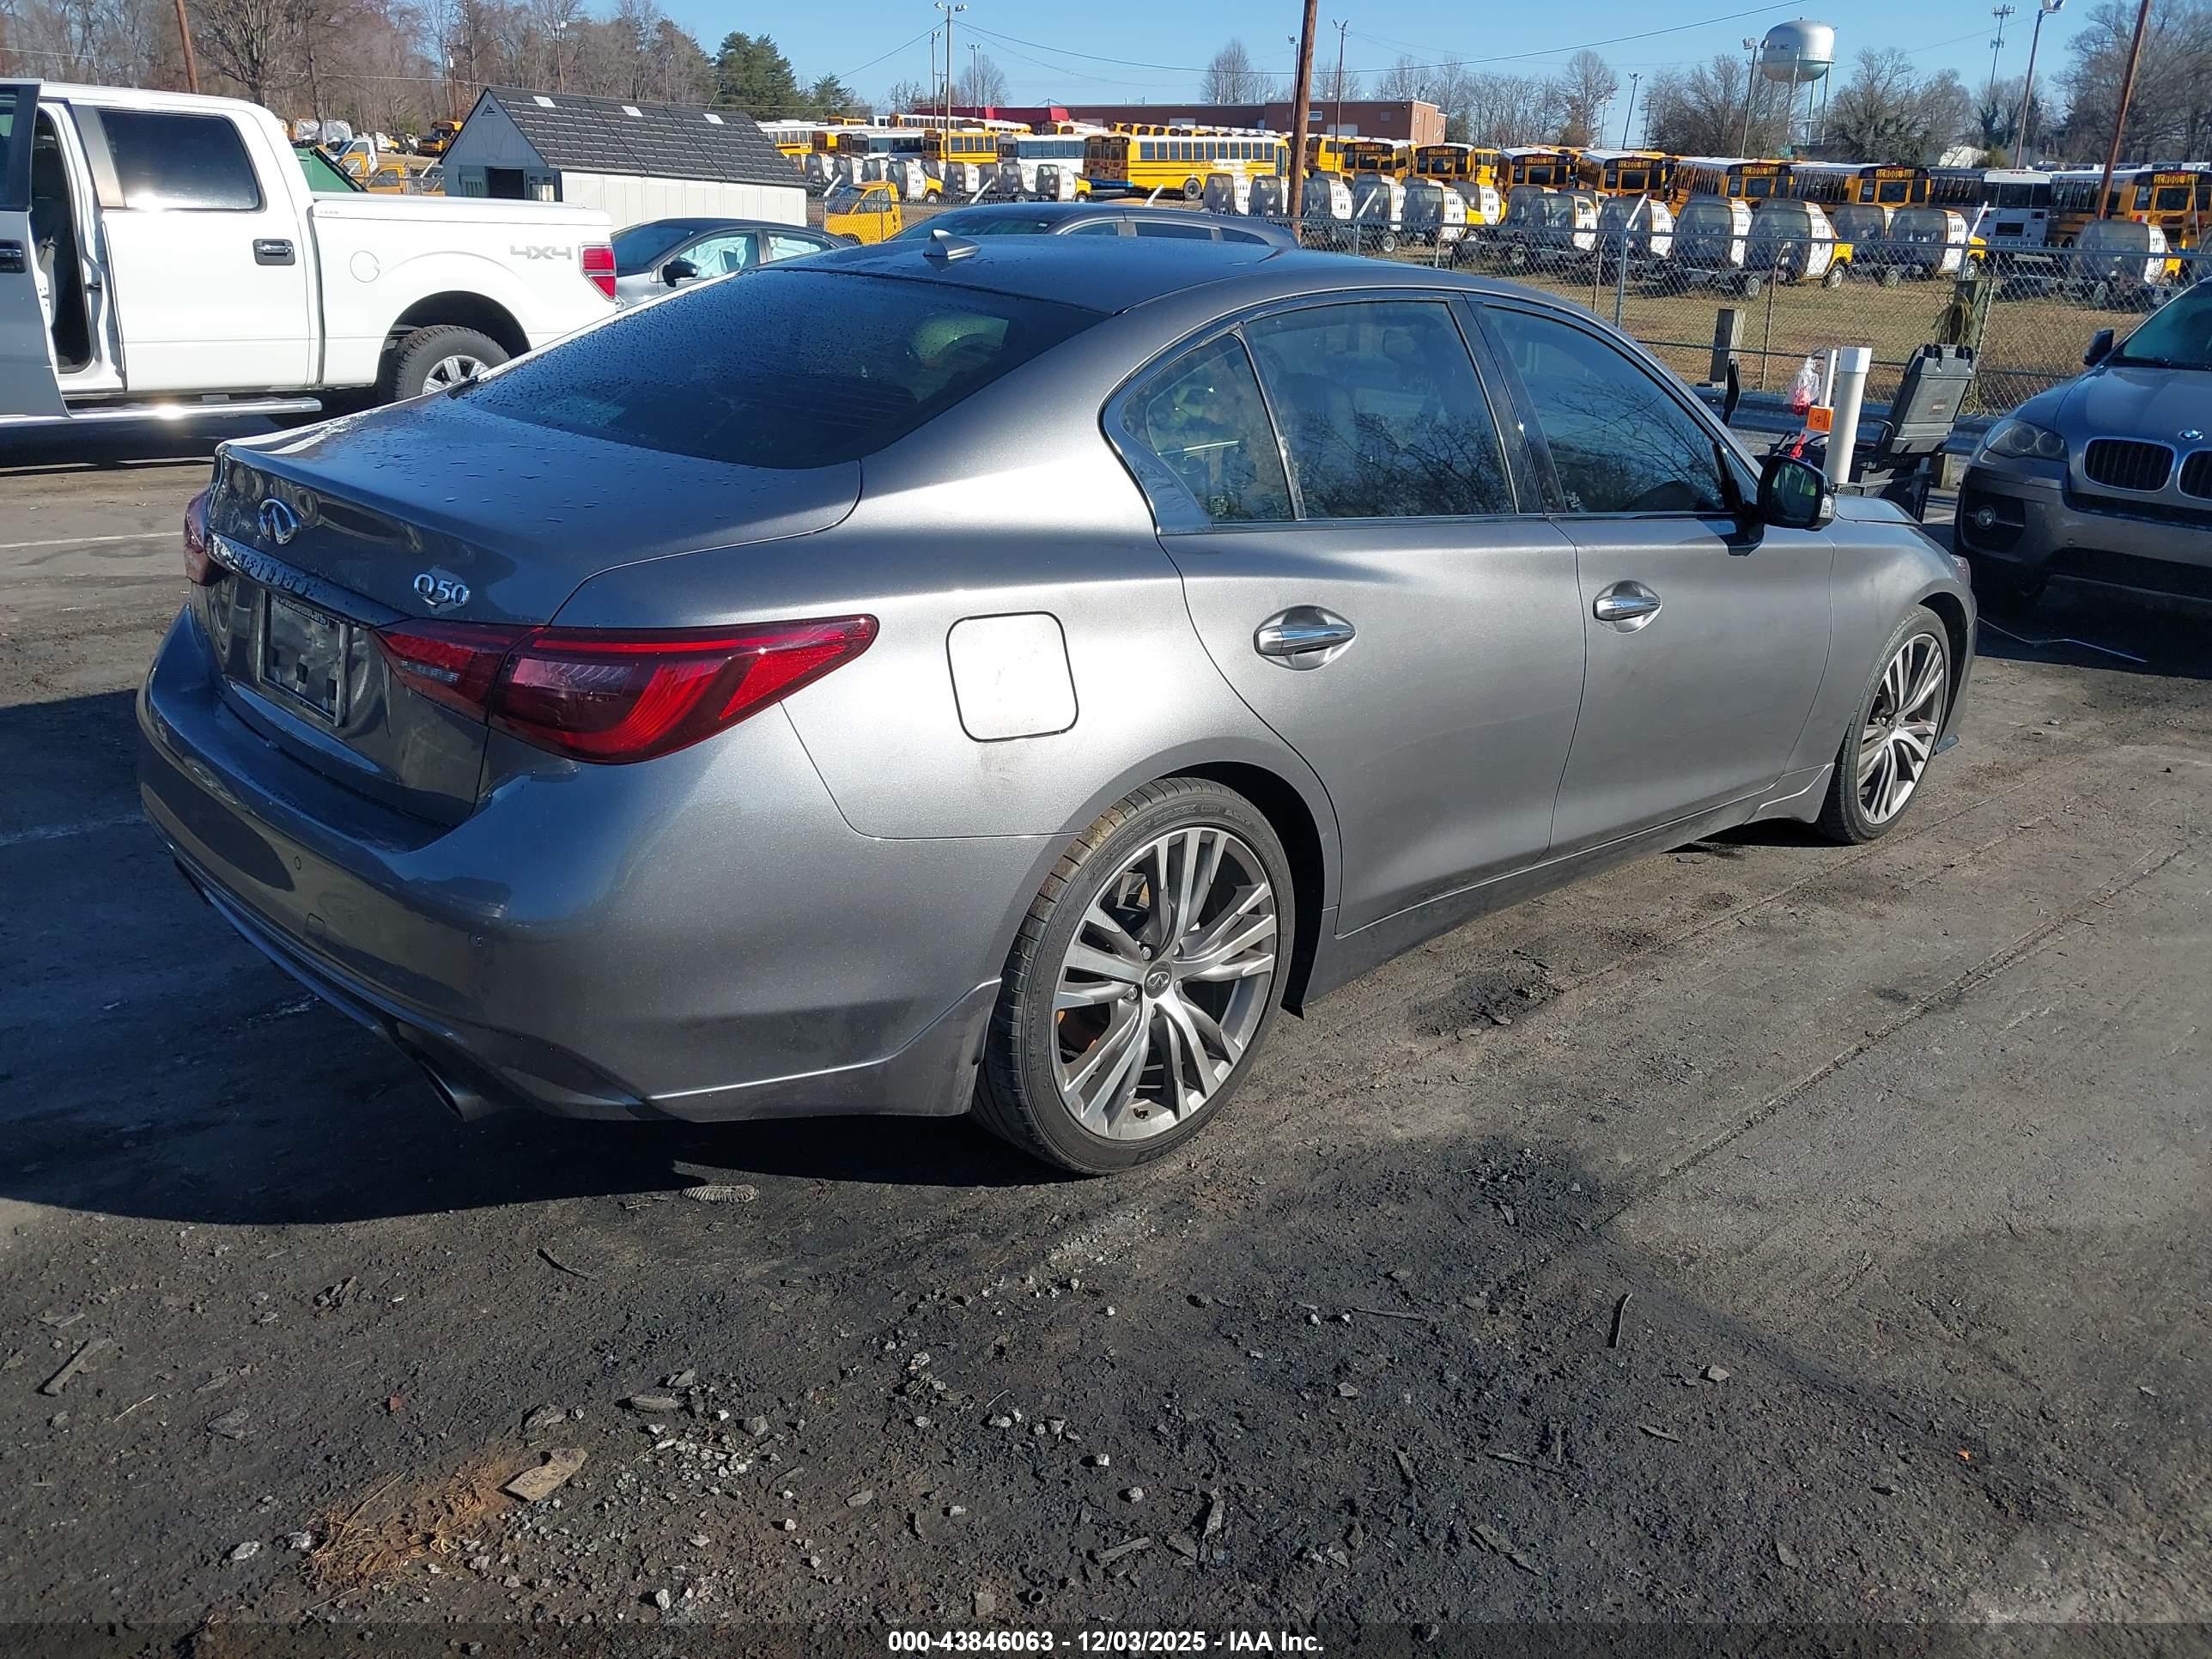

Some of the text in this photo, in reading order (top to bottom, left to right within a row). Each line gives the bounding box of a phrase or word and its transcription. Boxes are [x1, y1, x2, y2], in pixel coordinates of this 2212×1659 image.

[1877, 169, 1904, 179] SCHOOL
[2155, 174, 2185, 184] SCHOOL
[414, 574, 471, 606] Q50
